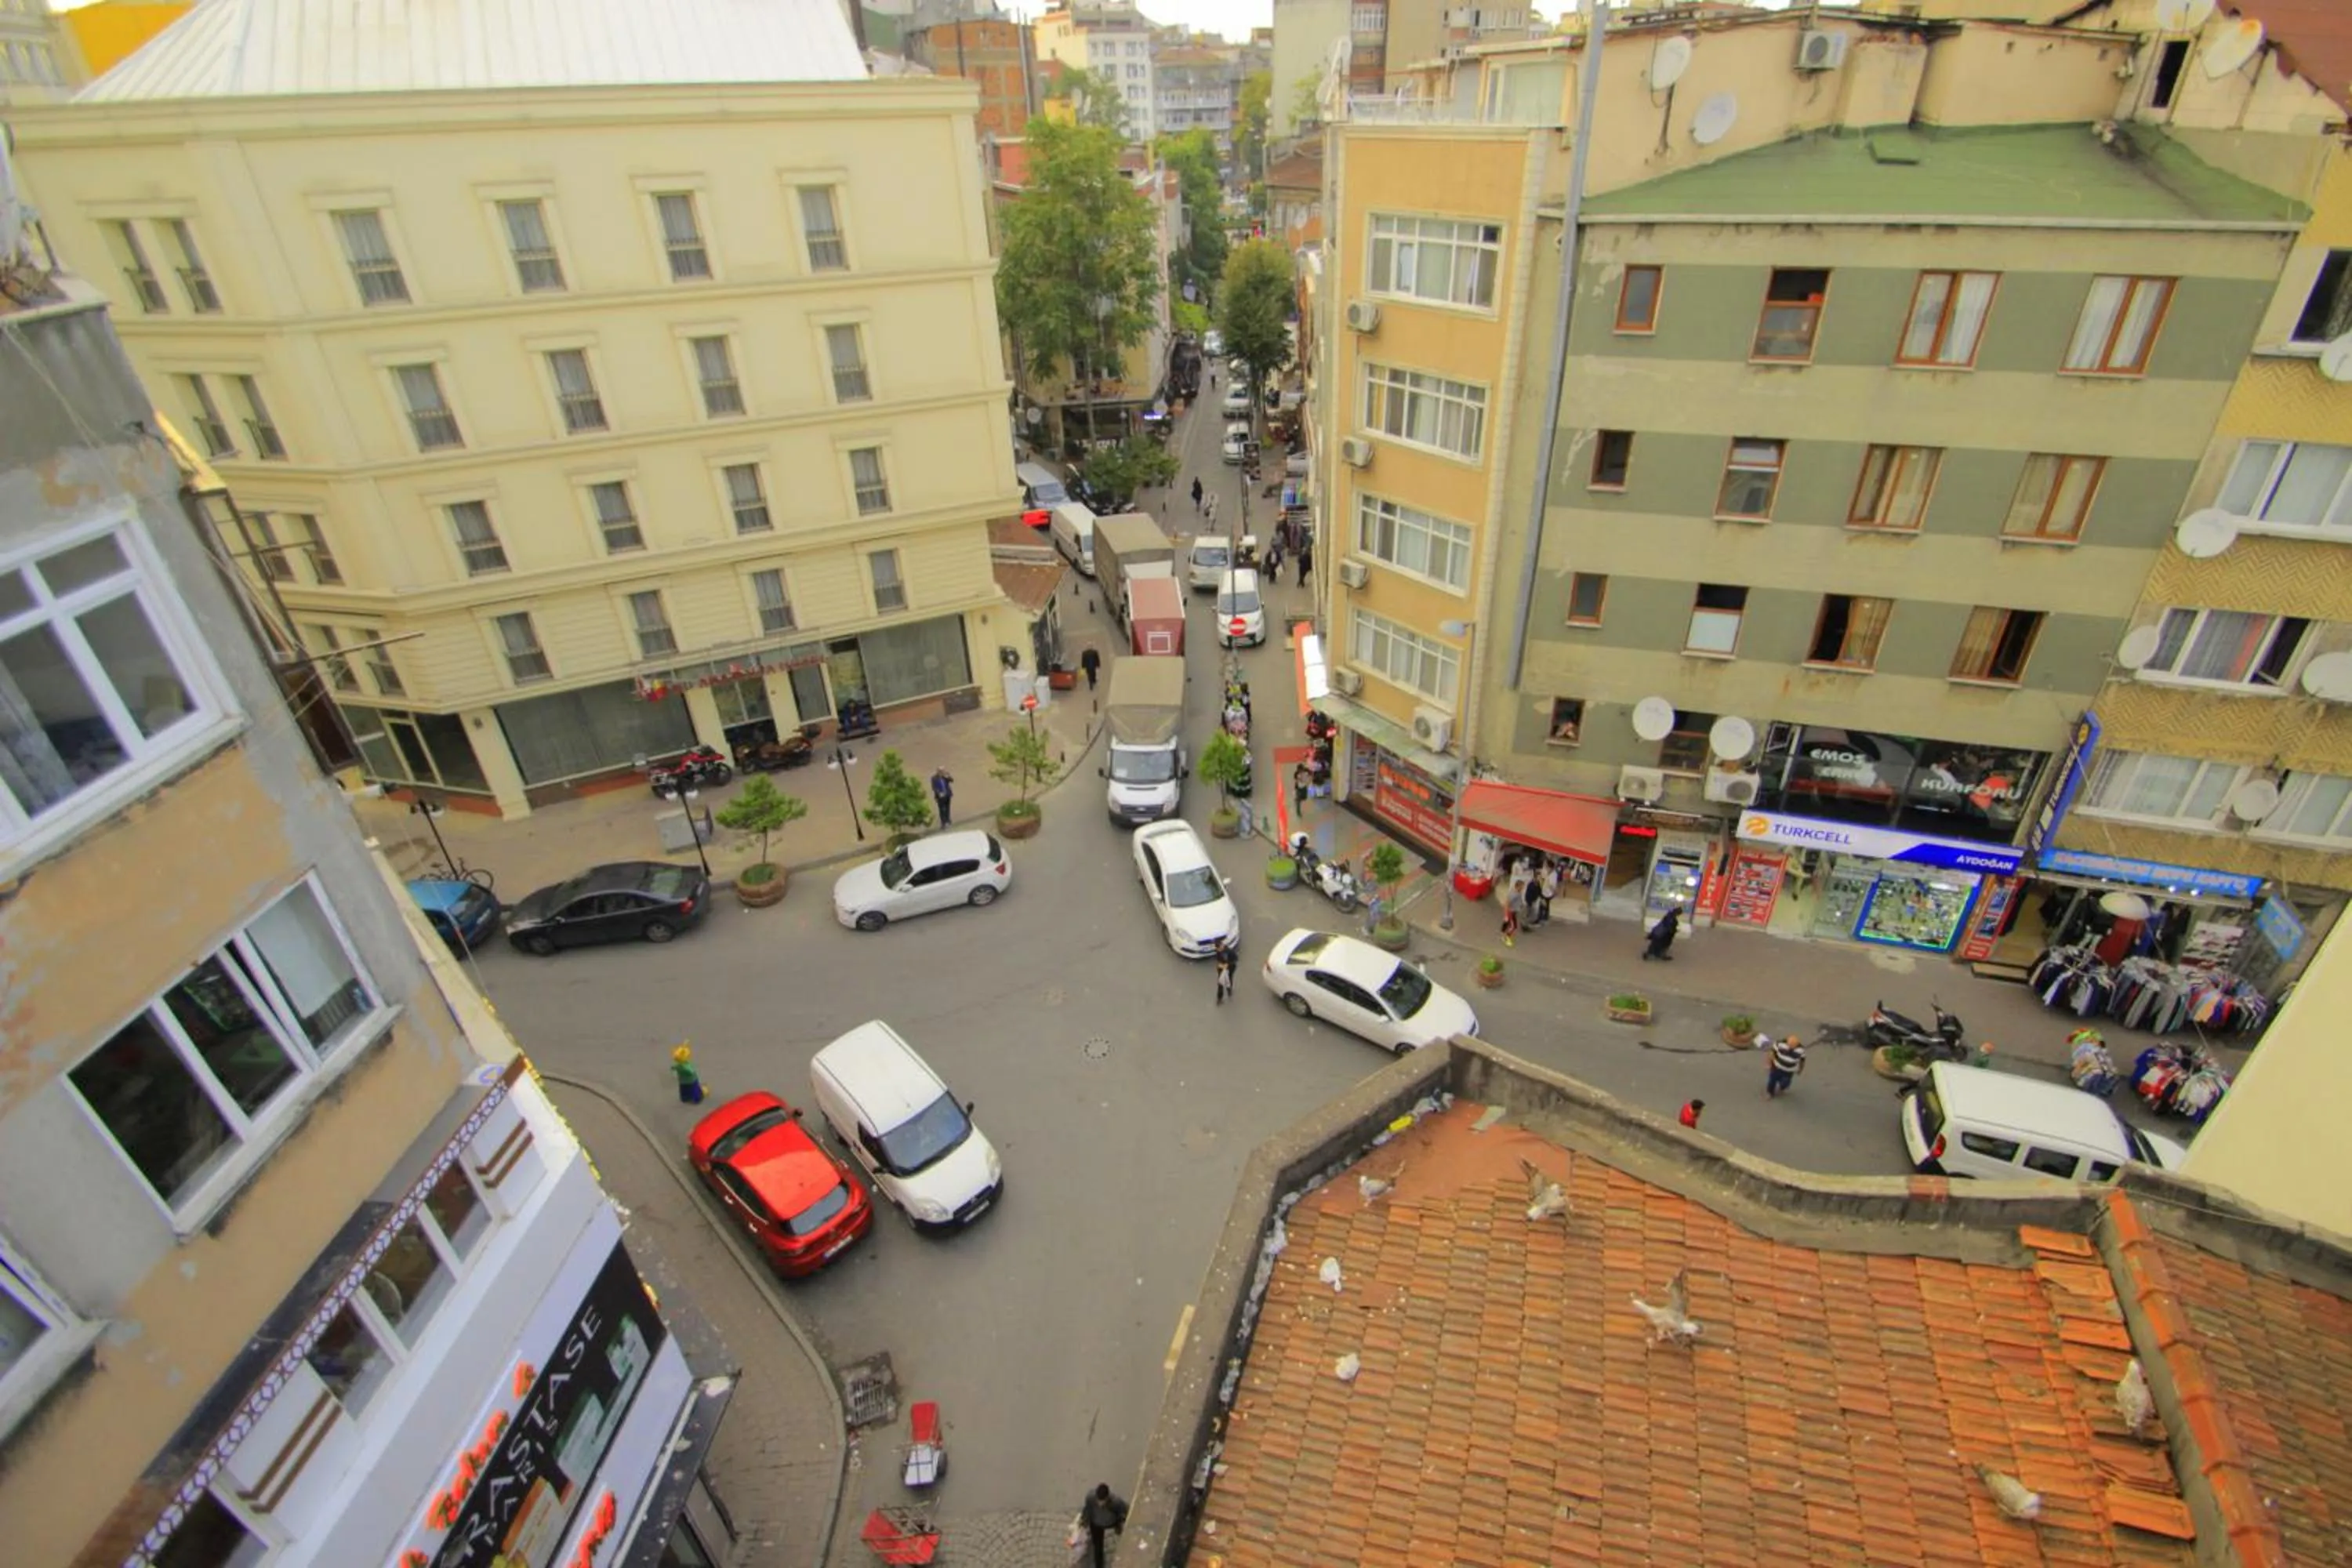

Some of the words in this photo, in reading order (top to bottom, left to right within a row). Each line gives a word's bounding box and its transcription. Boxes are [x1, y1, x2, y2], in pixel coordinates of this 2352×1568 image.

[1774, 824, 1852, 844] TURKCELL
[1957, 855, 2013, 870] AYDOĞAN
[459, 1305, 602, 1562] RASTASE
[484, 1417, 559, 1547] PARIS
